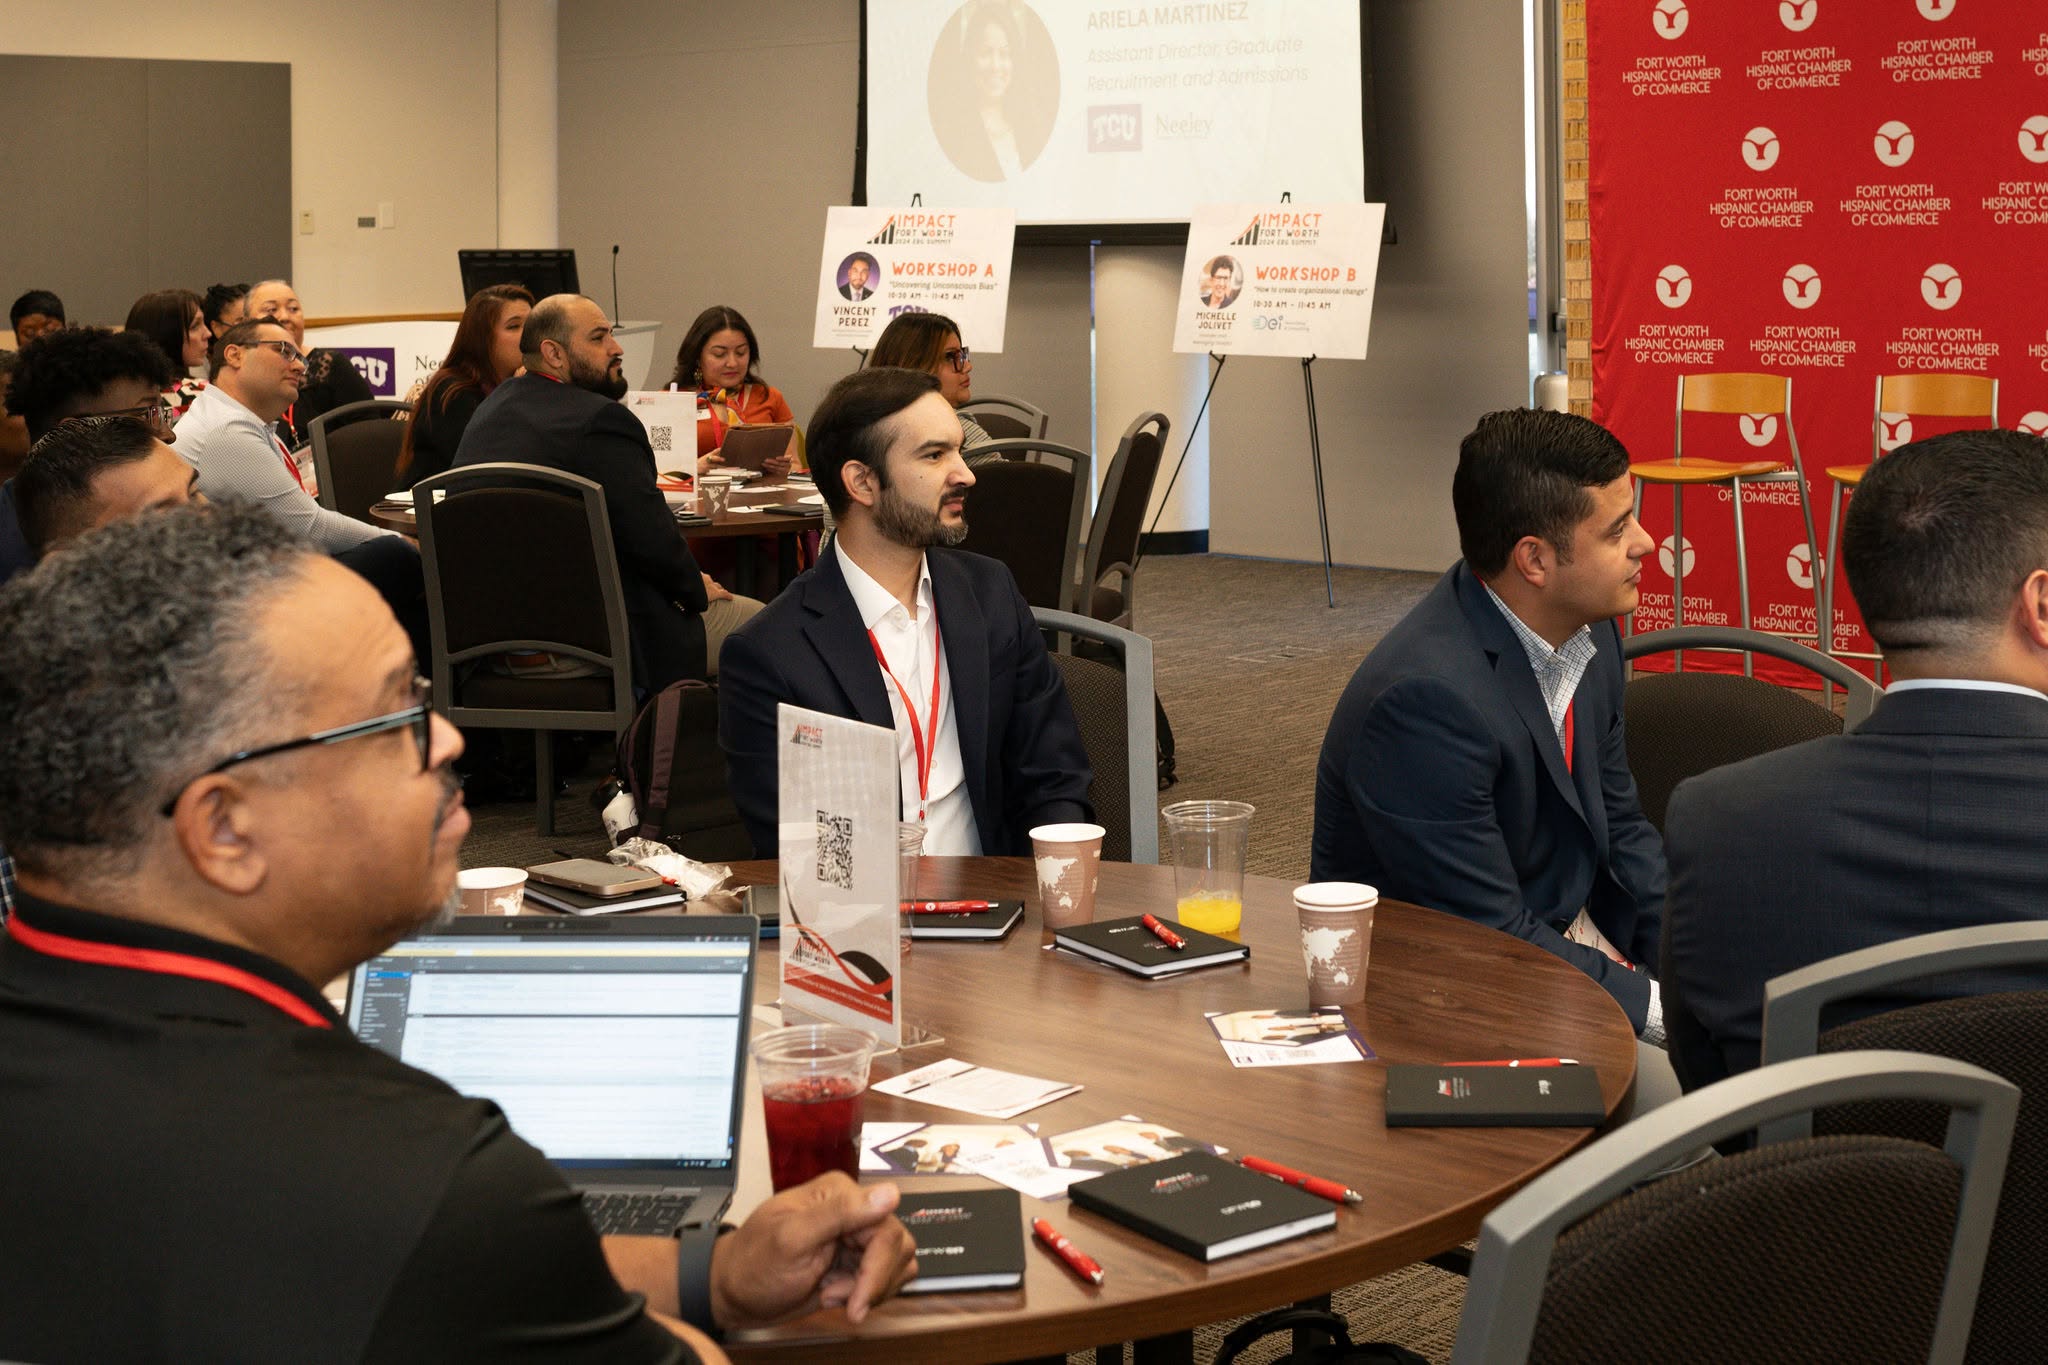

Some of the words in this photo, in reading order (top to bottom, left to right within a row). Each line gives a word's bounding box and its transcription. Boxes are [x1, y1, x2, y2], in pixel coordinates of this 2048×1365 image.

[1088, 8, 1149, 31] ARIELA
[1154, 2, 1249, 25] MARTINEZ
[1088, 46, 1154, 63] Assistant
[1226, 36, 1304, 56] Graduate
[1898, 40, 1928, 53] FORT
[1930, 38, 1975, 51] WORTH
[1762, 50, 1789, 62] FORT
[1792, 47, 1835, 60] WORTH
[1882, 55, 1933, 70] HISPANIC
[1935, 51, 1993, 67] CHAMBER
[1637, 57, 1663, 69] FORT
[1666, 56, 1705, 67] WORTH
[1747, 63, 1795, 77] HISPANIC
[1797, 60, 1851, 75] CHAMBER
[1087, 71, 1178, 90] Recruitment
[1182, 69, 1214, 86] and
[1219, 64, 1309, 83] Admissions
[1623, 70, 1667, 83] HISPANIC
[1670, 68, 1721, 82] CHAMBER
[1893, 69, 1912, 82] OF
[1913, 66, 1981, 81] COMMERCE
[1757, 78, 1776, 90] OF
[1777, 74, 1840, 89] COMMERCE
[1633, 84, 1650, 96] OF
[1650, 82, 1710, 95] COMMERCE
[1093, 112, 1136, 144] TCU
[1725, 189, 1753, 201] FORT
[1756, 188, 1797, 200] WORTH
[1856, 185, 1886, 197] FORT
[1889, 185, 1933, 197] WORTH
[1999, 182, 2031, 195] FORT
[1710, 202, 1757, 214] HISPANIC
[1760, 201, 1813, 213] CHAMBER
[1841, 199, 1891, 212] HISPANIC
[1894, 198, 1950, 211] CHAMBER
[1983, 196, 2036, 209] HISPANIC
[897, 215, 956, 227] IMPACT
[1262, 213, 1322, 227] IMPACT
[1721, 216, 1739, 228] OF
[1739, 215, 1802, 227] COMMERCE
[1852, 214, 1870, 225] OF
[1871, 212, 1938, 225] COMMERCE
[1994, 211, 2011, 224] OF
[895, 229, 917, 237] FORT
[922, 229, 954, 237] WORTH
[1260, 229, 1281, 237] FORT
[1287, 229, 1320, 237] WORTH
[892, 262, 978, 277] WORKSHOP
[984, 263, 993, 277] A
[1256, 266, 1340, 281] WORKSHOP
[1347, 267, 1356, 282] B
[933, 282, 977, 290] Unconscious
[1298, 287, 1341, 295] organizational
[833, 306, 876, 316] VINCENT
[1196, 312, 1236, 321] MICHELLE
[838, 317, 869, 327] PEREZ
[1198, 321, 1232, 330] JOLIVET
[1640, 325, 1666, 336] FORT
[1669, 325, 1708, 336] WORTH
[1766, 326, 1794, 338] FORT
[1797, 327, 1839, 338] WORTH
[1903, 328, 1933, 340] FORT
[1936, 328, 1981, 340] WORTH
[1625, 338, 1670, 350] HISPANIC
[1673, 338, 1724, 350] CHAMBER
[1750, 340, 1799, 352] HISPANIC
[1801, 340, 1855, 353] CHAMBER
[1887, 342, 1938, 354] HISPANIC
[1941, 342, 1999, 356] CHAMBER
[1635, 351, 1652, 362] OF
[1652, 352, 1713, 364] COMMERCE
[1761, 353, 1779, 365] OF
[1779, 354, 1844, 366] COMMERCE
[1898, 356, 1917, 368] OF
[1918, 356, 1986, 370] COMMERCE
[350, 356, 388, 387] CU
[1718, 488, 1734, 502] OF
[1642, 593, 1669, 605] FORT
[1682, 596, 1712, 610] ORTH
[1769, 604, 1798, 616] FORT
[1683, 610, 1728, 625] HAMBER
[1753, 616, 1802, 632] HISPANIC
[1638, 619, 1653, 632] OF
